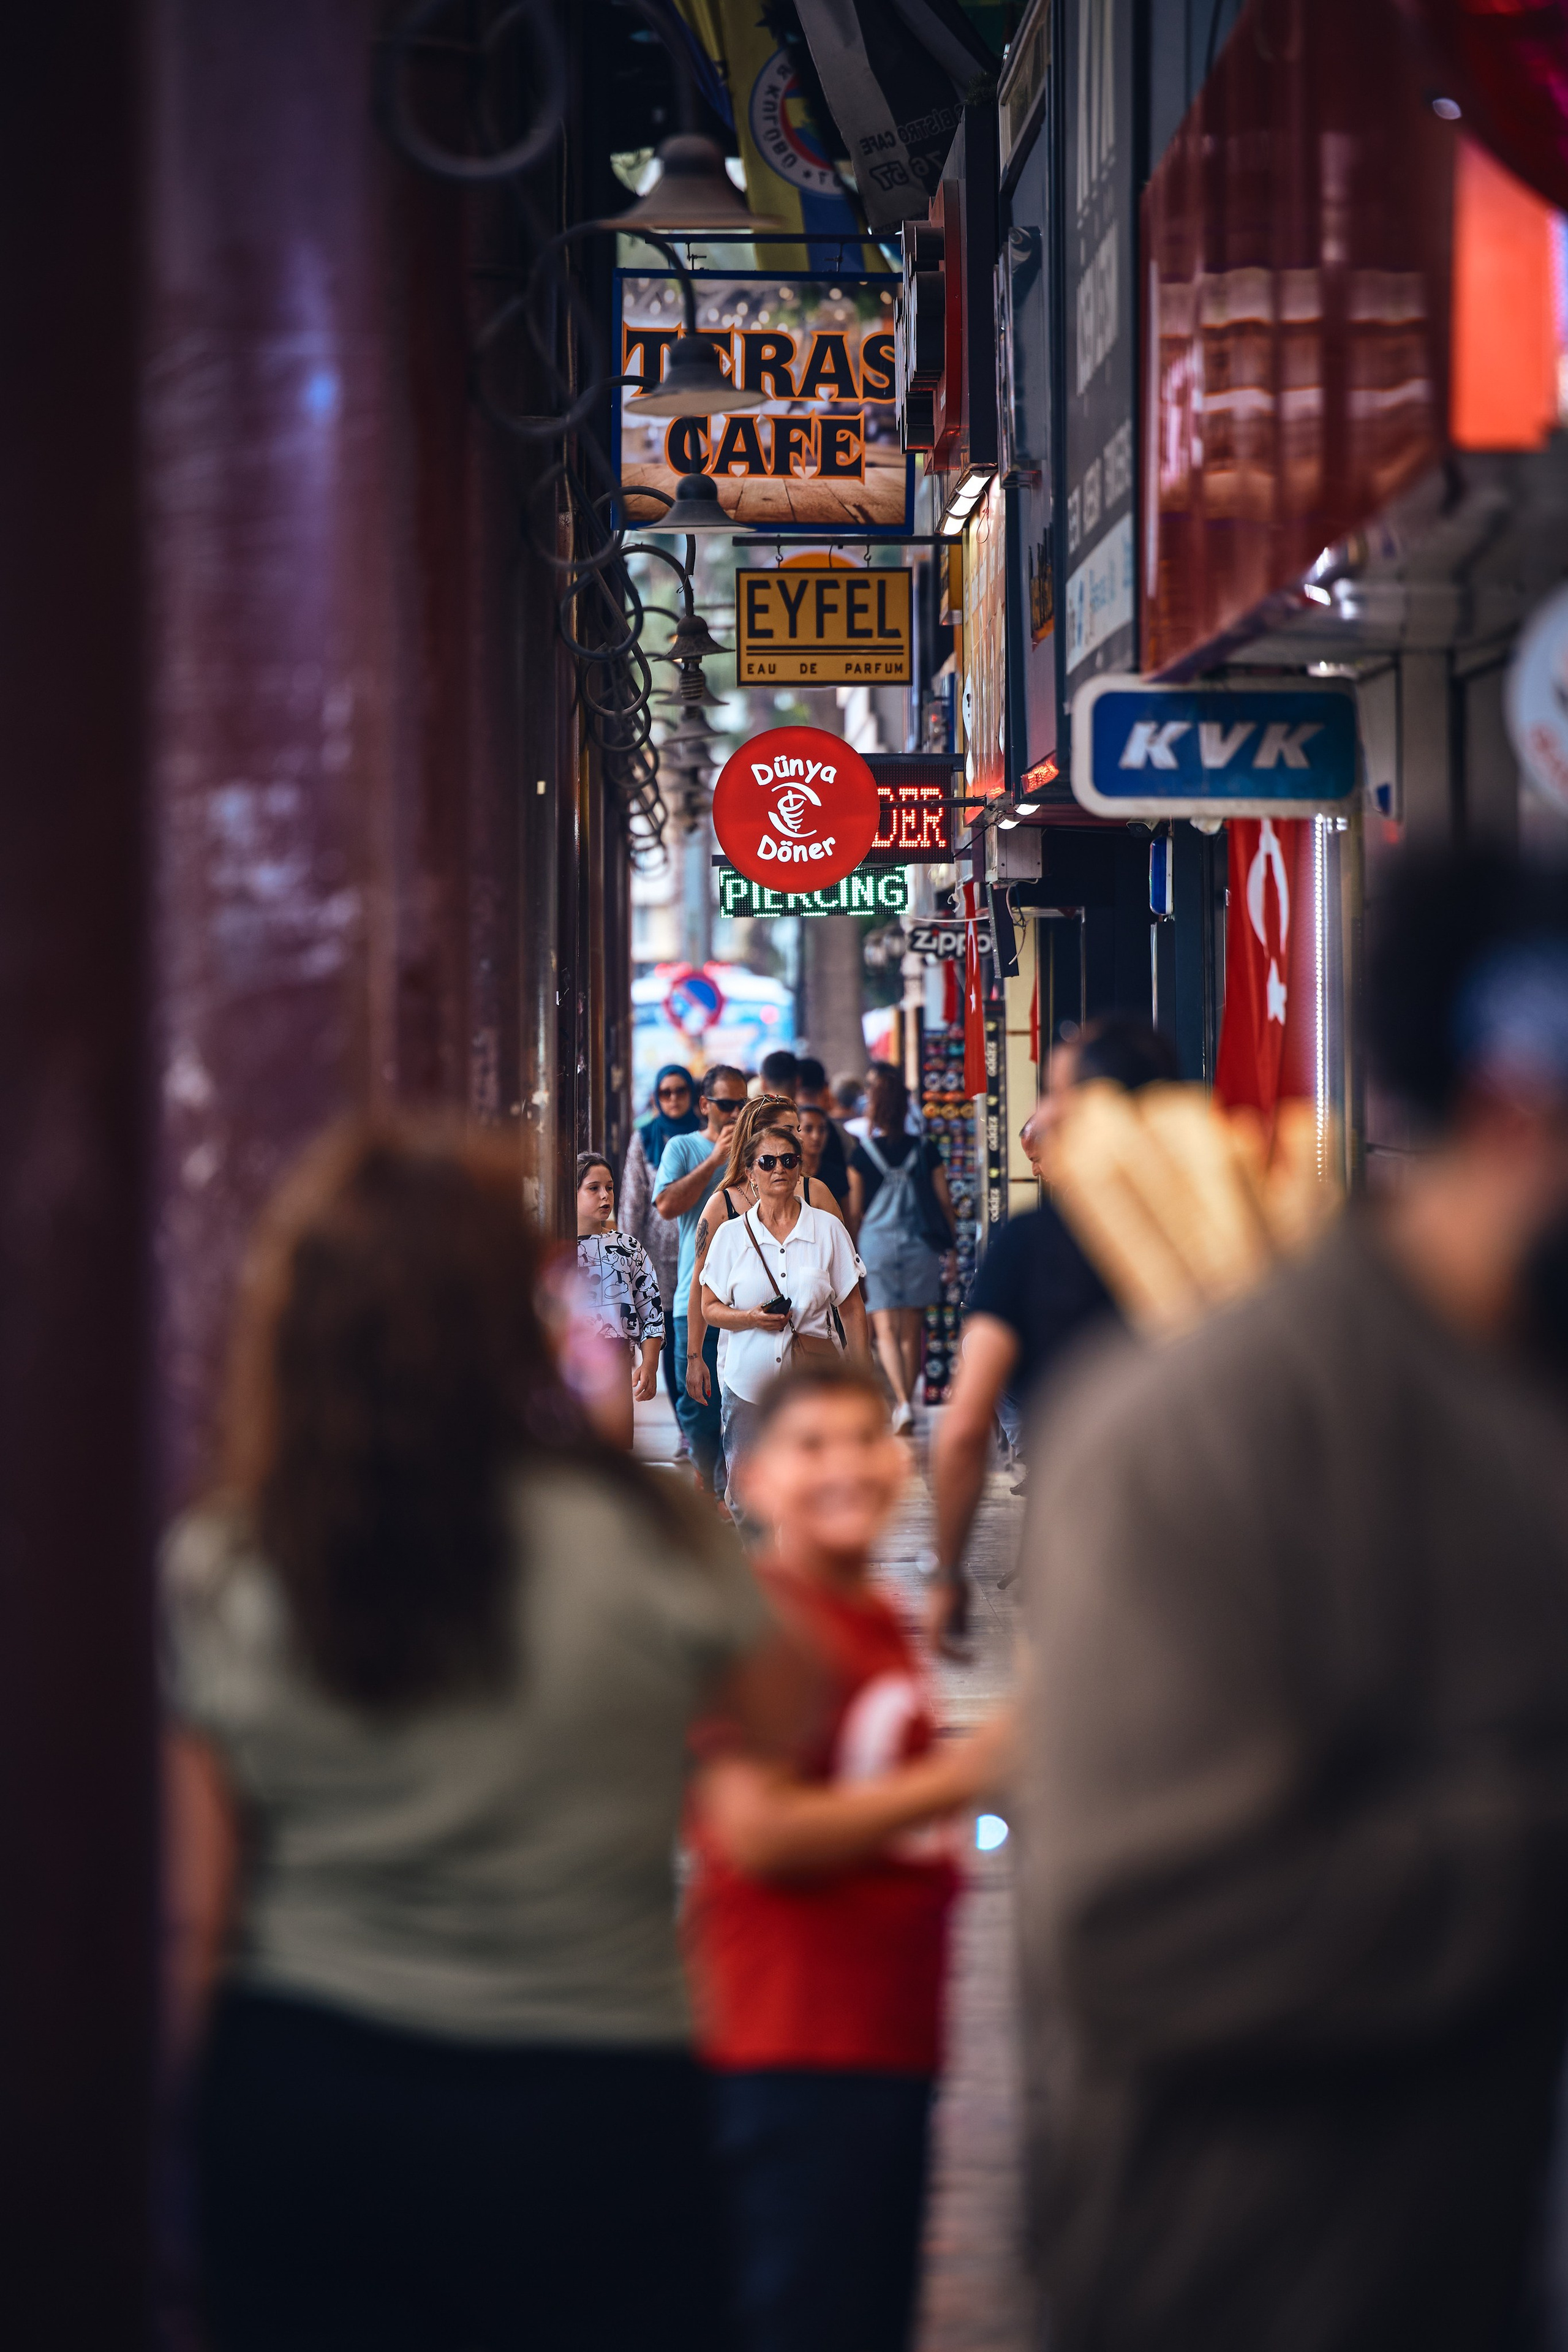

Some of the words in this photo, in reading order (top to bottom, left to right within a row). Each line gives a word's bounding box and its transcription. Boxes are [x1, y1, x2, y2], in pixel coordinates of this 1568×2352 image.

[665, 409, 865, 486] CAFE
[747, 579, 902, 638] EYFEL
[747, 663, 777, 674] EAU
[799, 663, 817, 674] DE
[845, 663, 903, 674] PARFUM
[1118, 721, 1325, 770] KVK
[751, 755, 837, 786] Dünya
[757, 834, 835, 862] Döner
